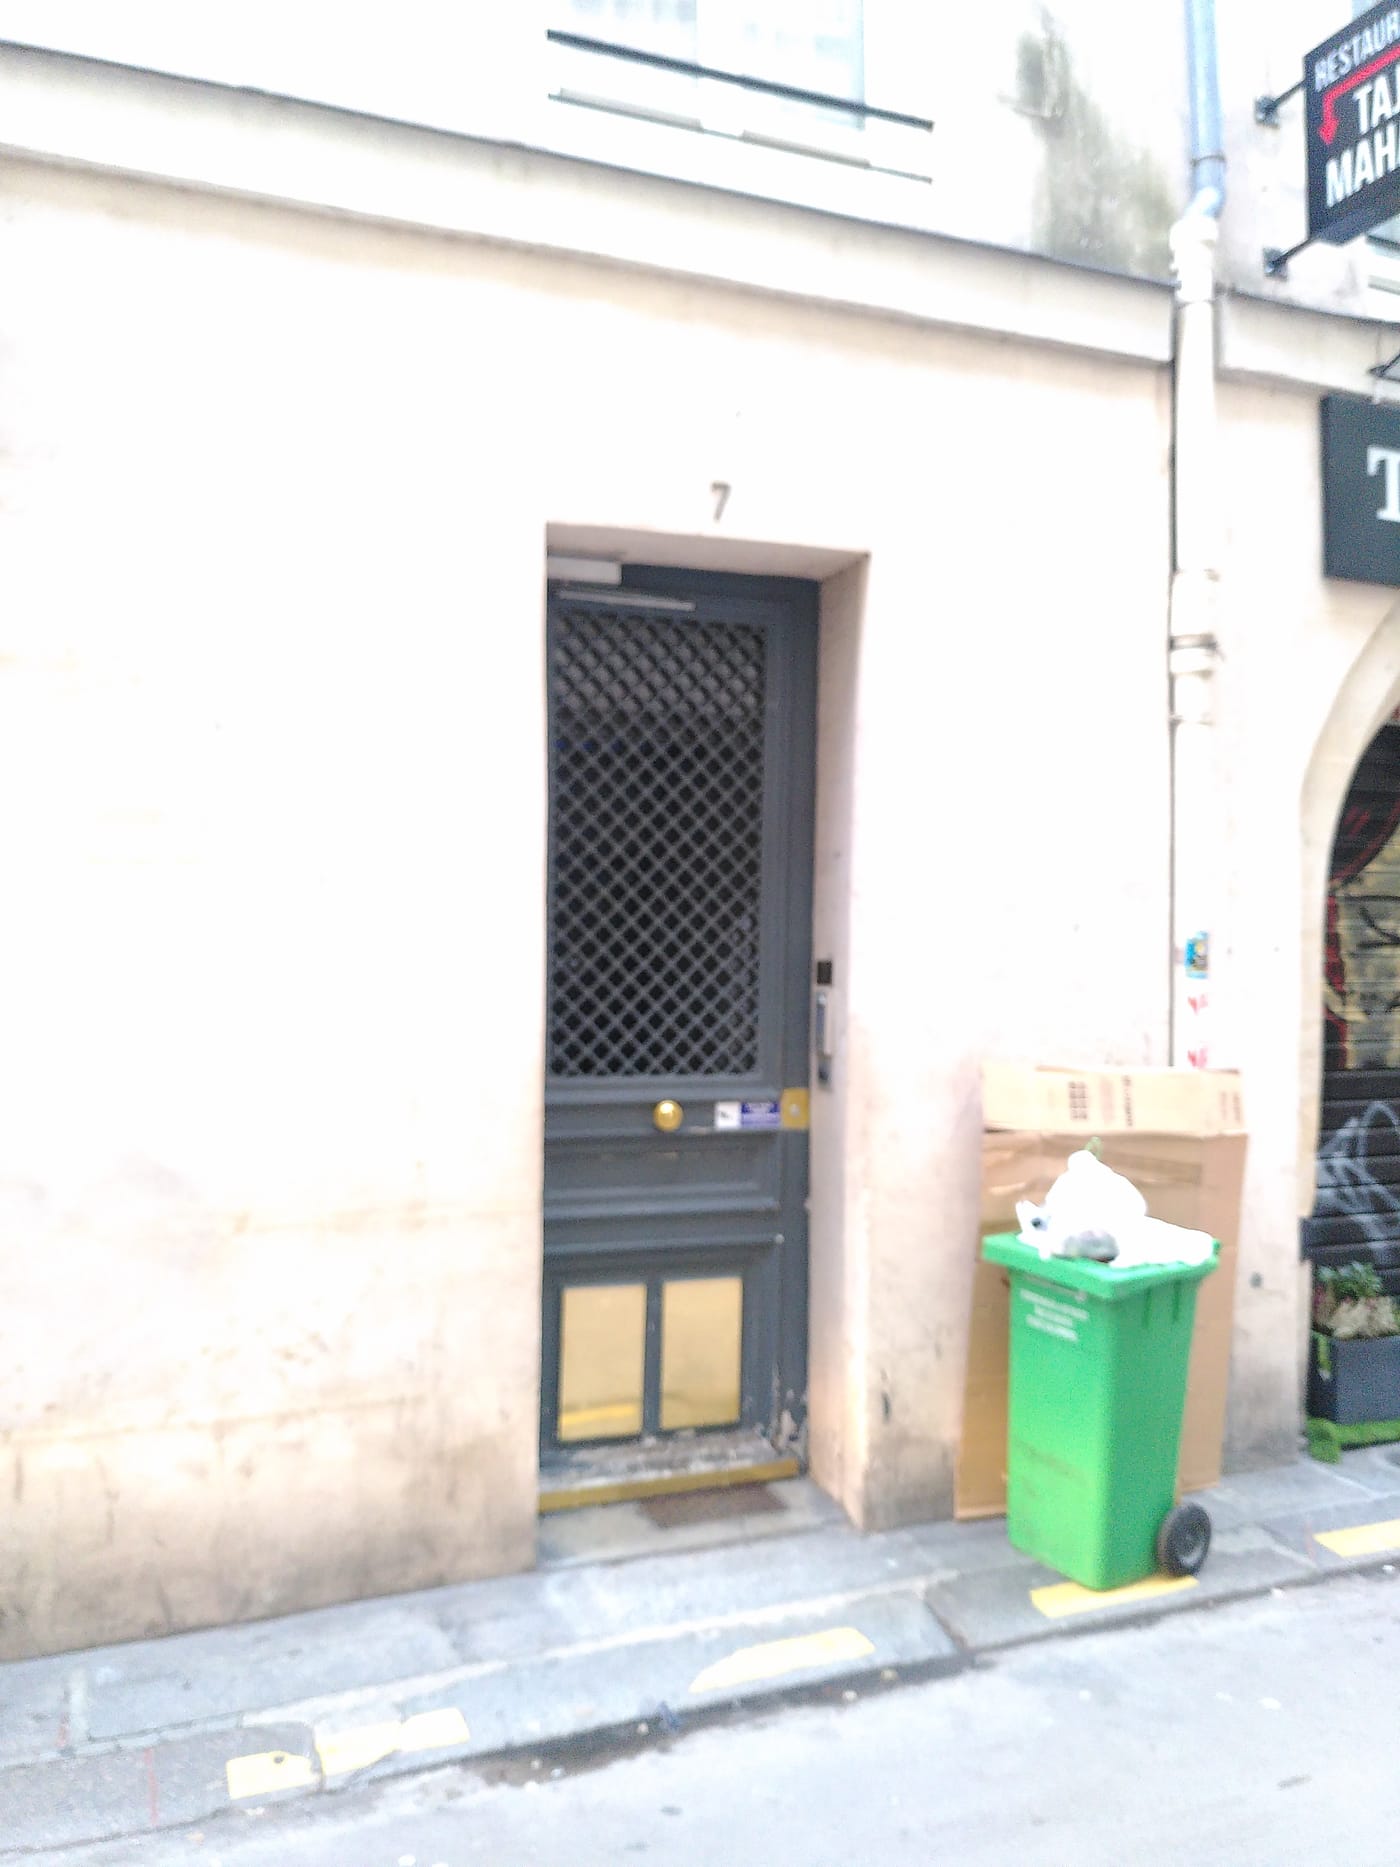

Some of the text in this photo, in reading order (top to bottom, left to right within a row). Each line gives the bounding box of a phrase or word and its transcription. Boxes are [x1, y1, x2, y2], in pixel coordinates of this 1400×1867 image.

[1315, 11, 1400, 92] RESTAUR
[1326, 122, 1400, 208] MAH
[711, 481, 731, 523] 7
